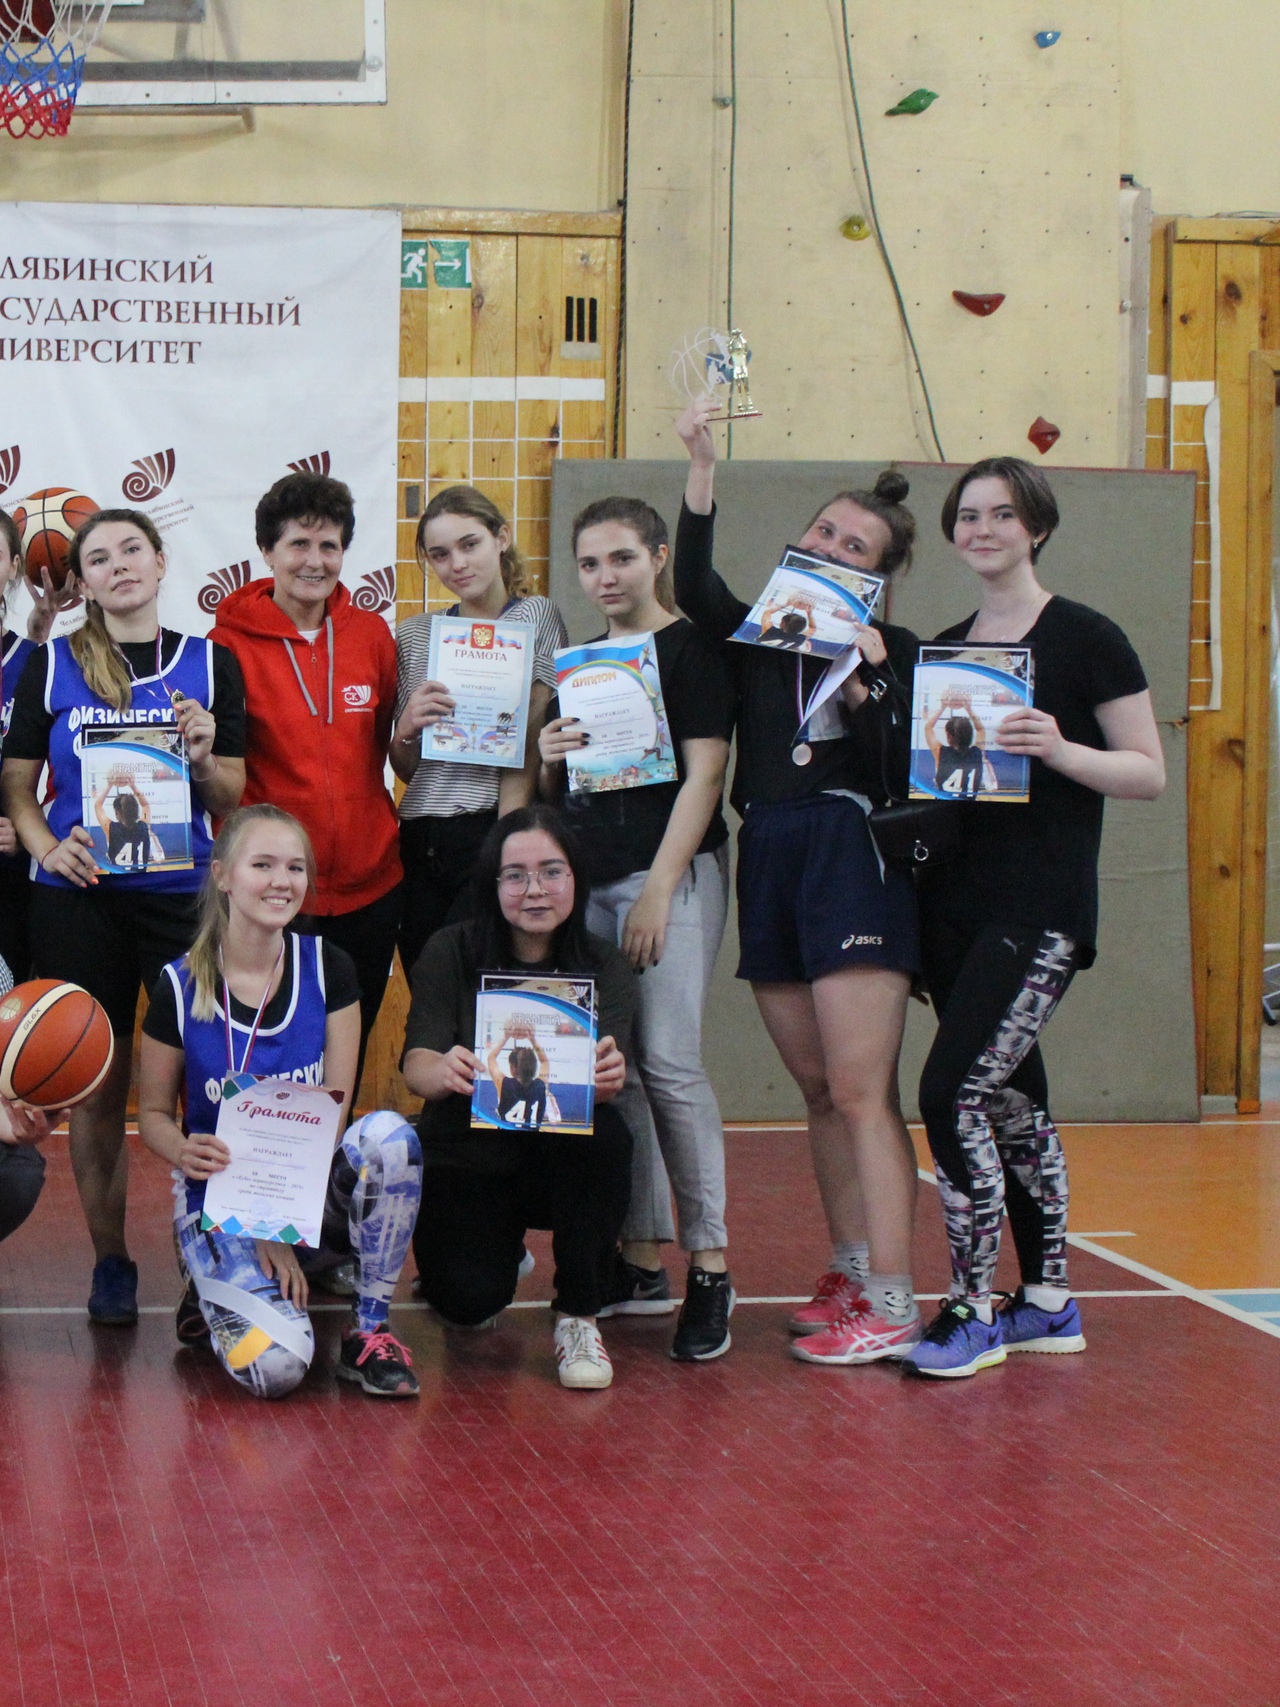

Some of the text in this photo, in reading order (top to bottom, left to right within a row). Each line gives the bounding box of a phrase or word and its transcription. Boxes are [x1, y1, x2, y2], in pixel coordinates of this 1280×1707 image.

[141, 497, 185, 515] елябинский
[454, 649, 508, 662] ГРАМОТА
[571, 671, 617, 688] ДИПЛОМ
[942, 768, 976, 797] 41
[115, 841, 146, 870] 41
[855, 935, 883, 946] asics
[22, 1007, 42, 1031] GL6X
[237, 1100, 322, 1126] Грамота
[505, 1099, 540, 1128] 41
[252, 1147, 293, 1159] НАГРАЖДАЕТ
